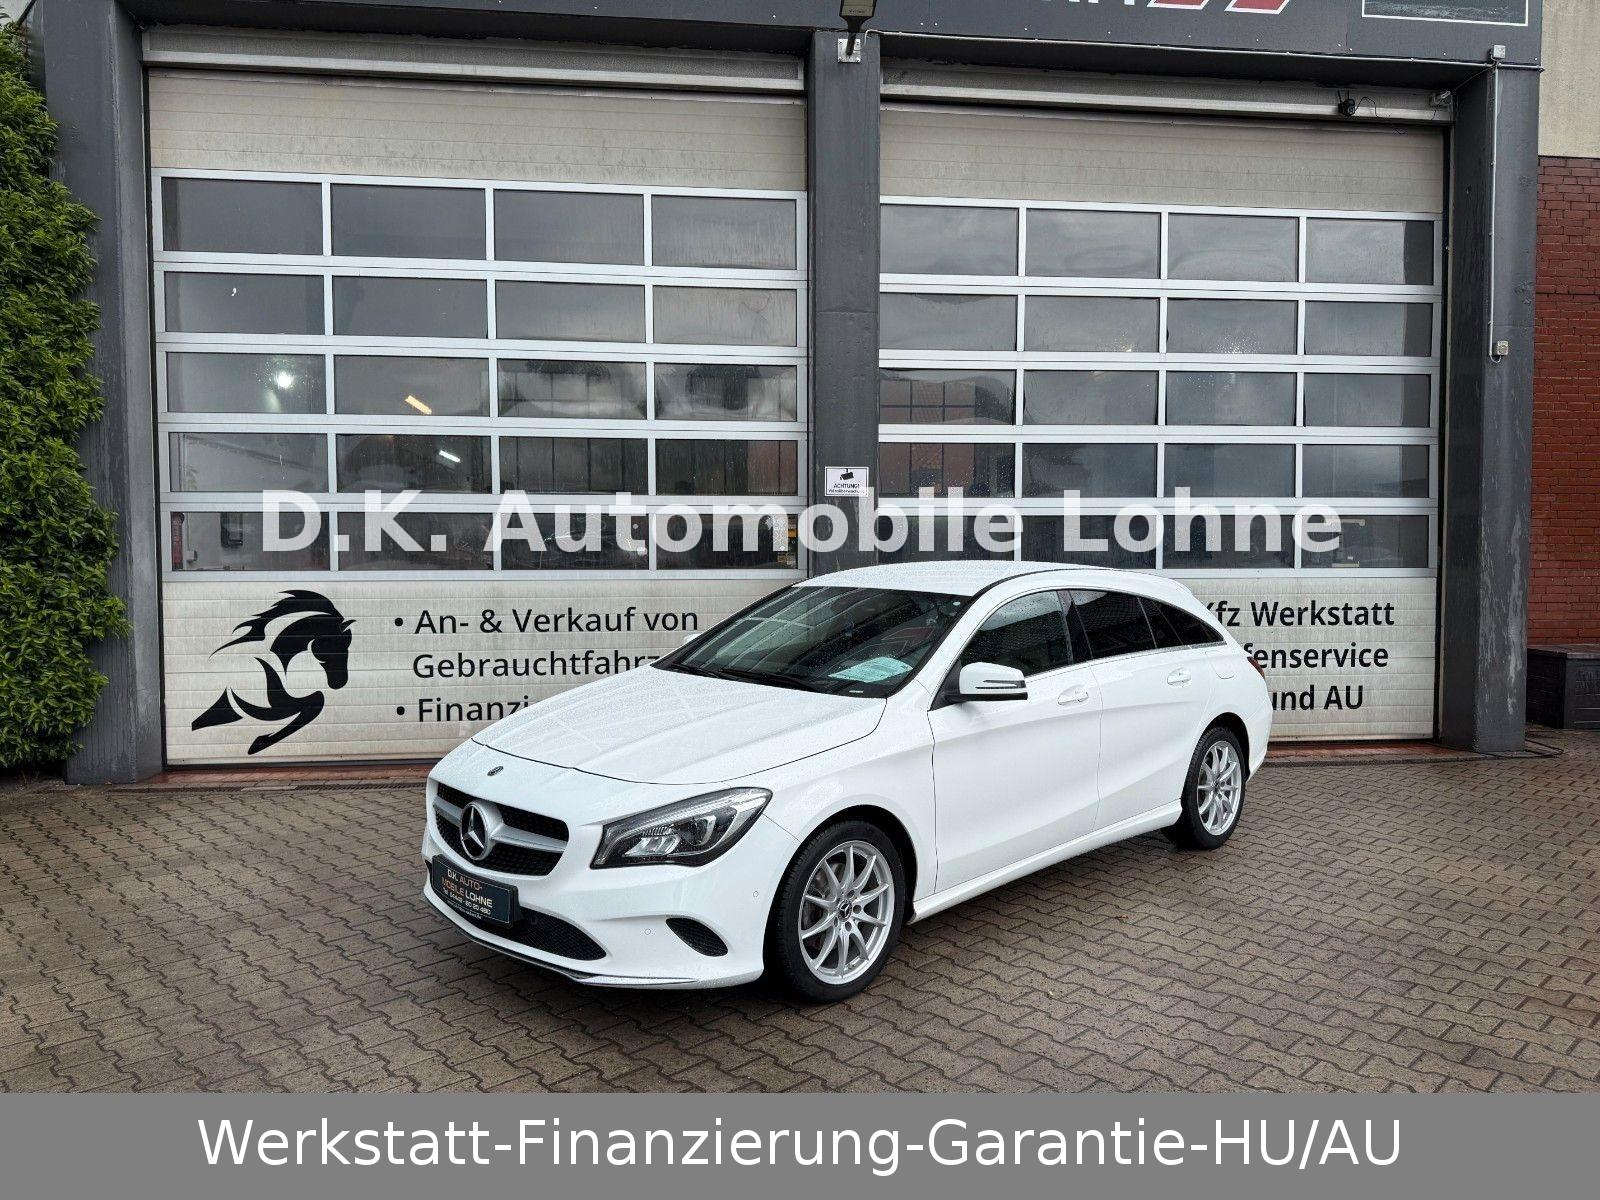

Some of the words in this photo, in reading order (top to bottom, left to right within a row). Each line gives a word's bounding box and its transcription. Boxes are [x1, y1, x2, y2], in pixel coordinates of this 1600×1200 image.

[414, 609, 469, 634] An-
[480, 608, 503, 633] &
[512, 606, 637, 633] Verkauf
[643, 611, 699, 631] von
[1250, 600, 1395, 627] Werkstatt
[1323, 685, 1364, 710] AU
[465, 889, 493, 908] LOHNE
